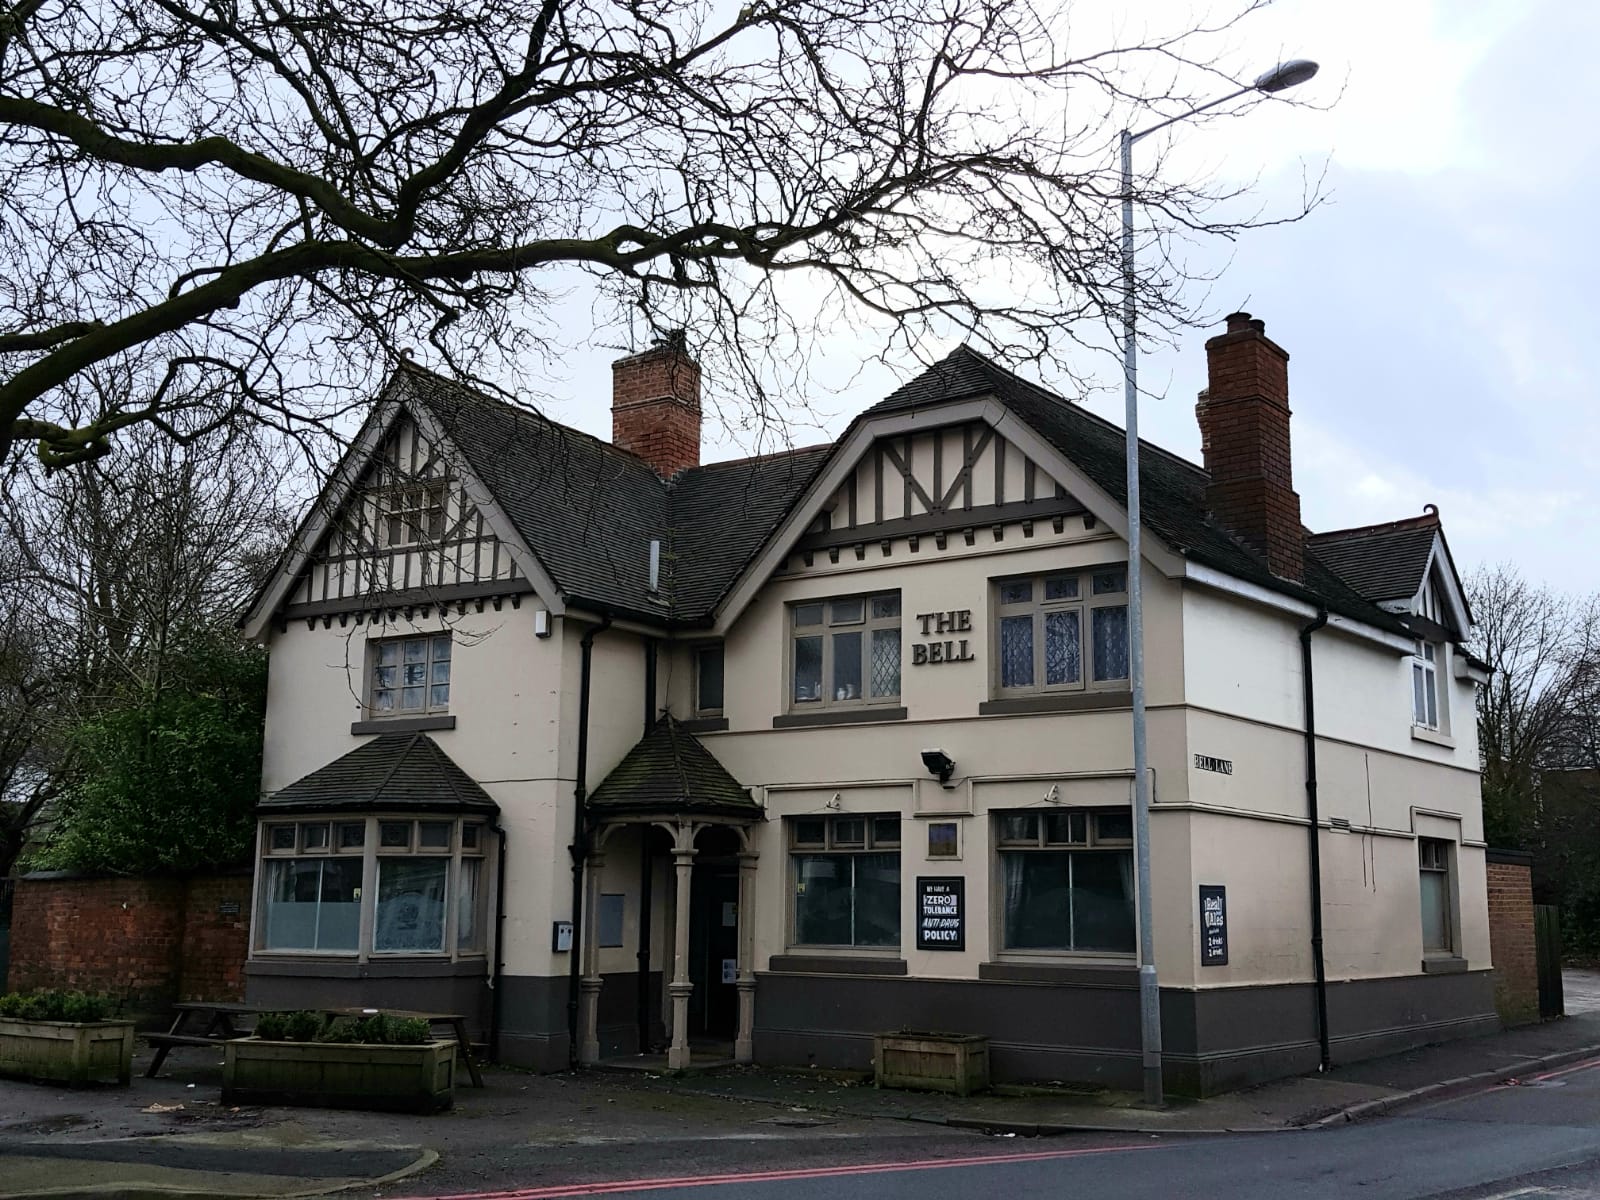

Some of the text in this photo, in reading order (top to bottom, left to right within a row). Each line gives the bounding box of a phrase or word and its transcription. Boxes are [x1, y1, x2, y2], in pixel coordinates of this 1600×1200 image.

[916, 610, 971, 635] THE
[912, 640, 974, 665] BELL
[1194, 755, 1232, 774] BELL LANE
[926, 895, 951, 905] ZERO
[1206, 896, 1220, 911] Real
[923, 906, 958, 914] TOLERANCE
[1209, 912, 1224, 926] Ales
[924, 930, 956, 941] POLICY
